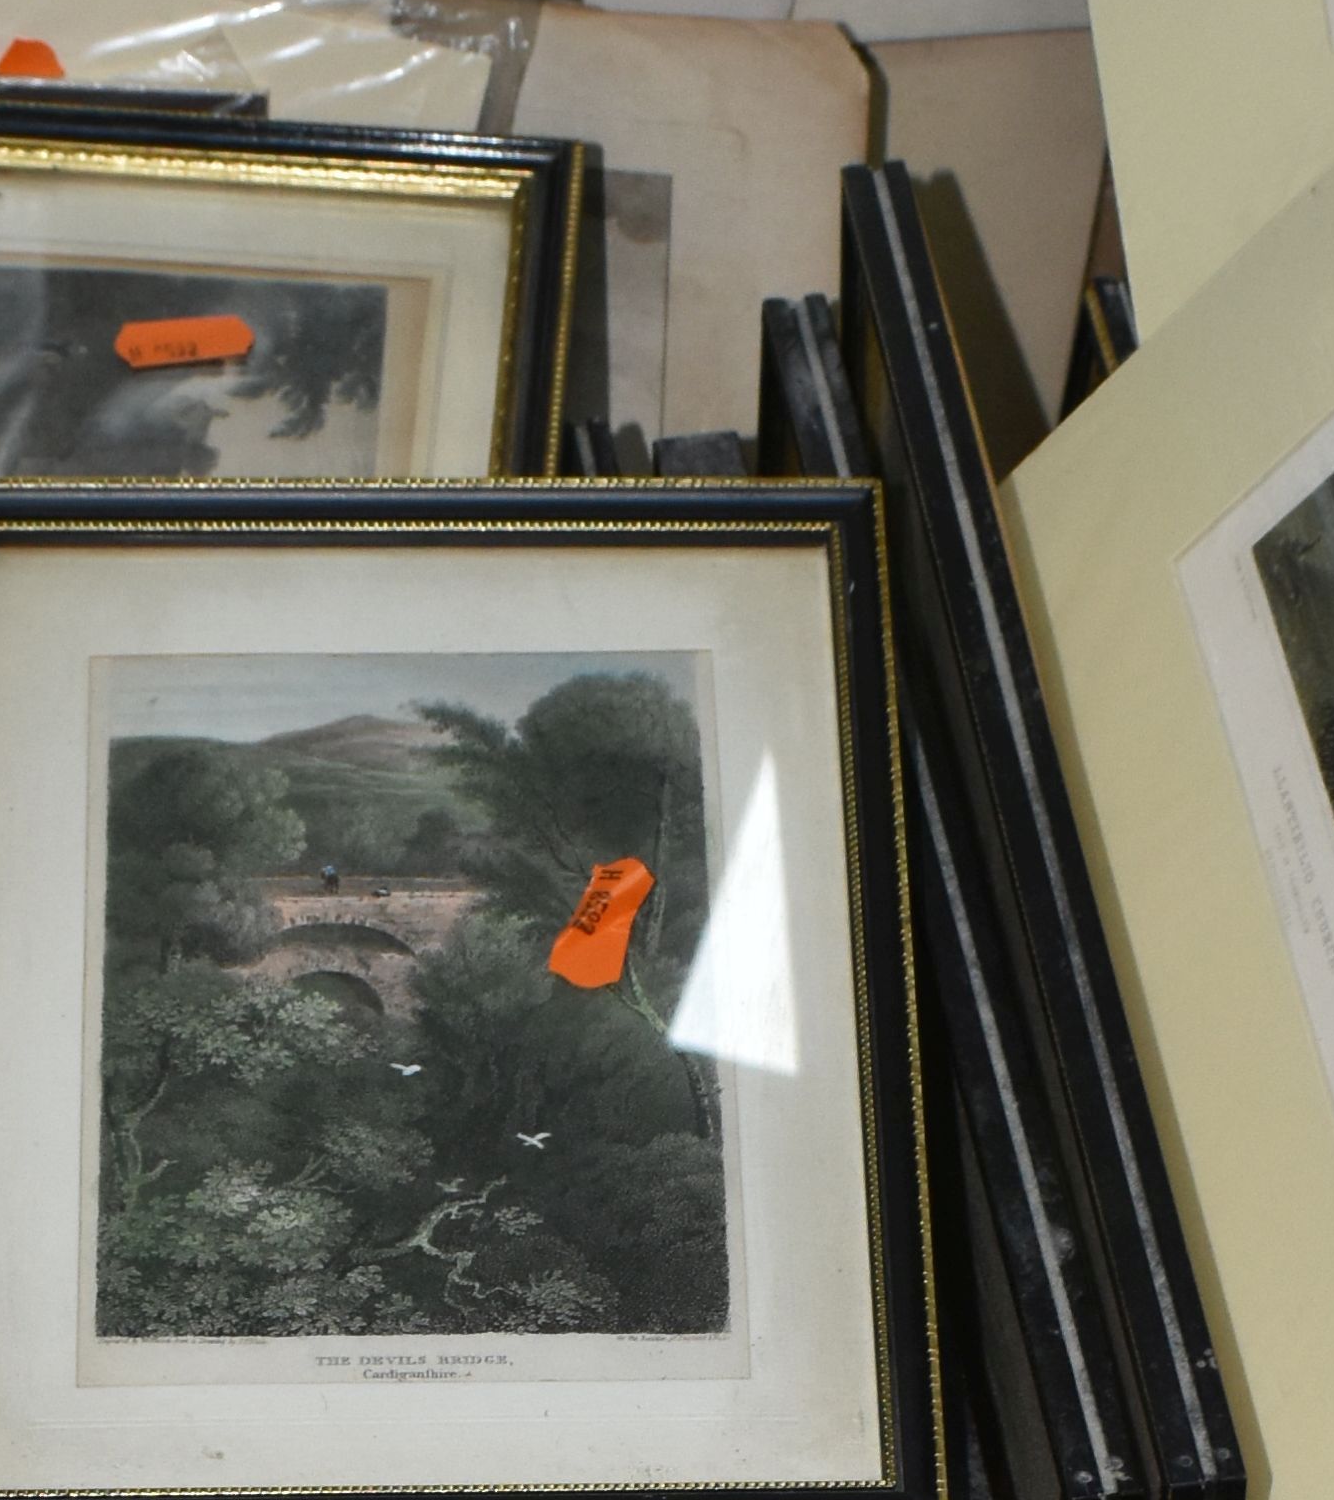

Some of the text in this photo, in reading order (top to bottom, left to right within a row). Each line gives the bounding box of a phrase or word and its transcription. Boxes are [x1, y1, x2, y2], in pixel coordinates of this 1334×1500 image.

[600, 869, 623, 881] H
[315, 1356, 351, 1366] THE
[360, 1355, 427, 1365] DEVILS
